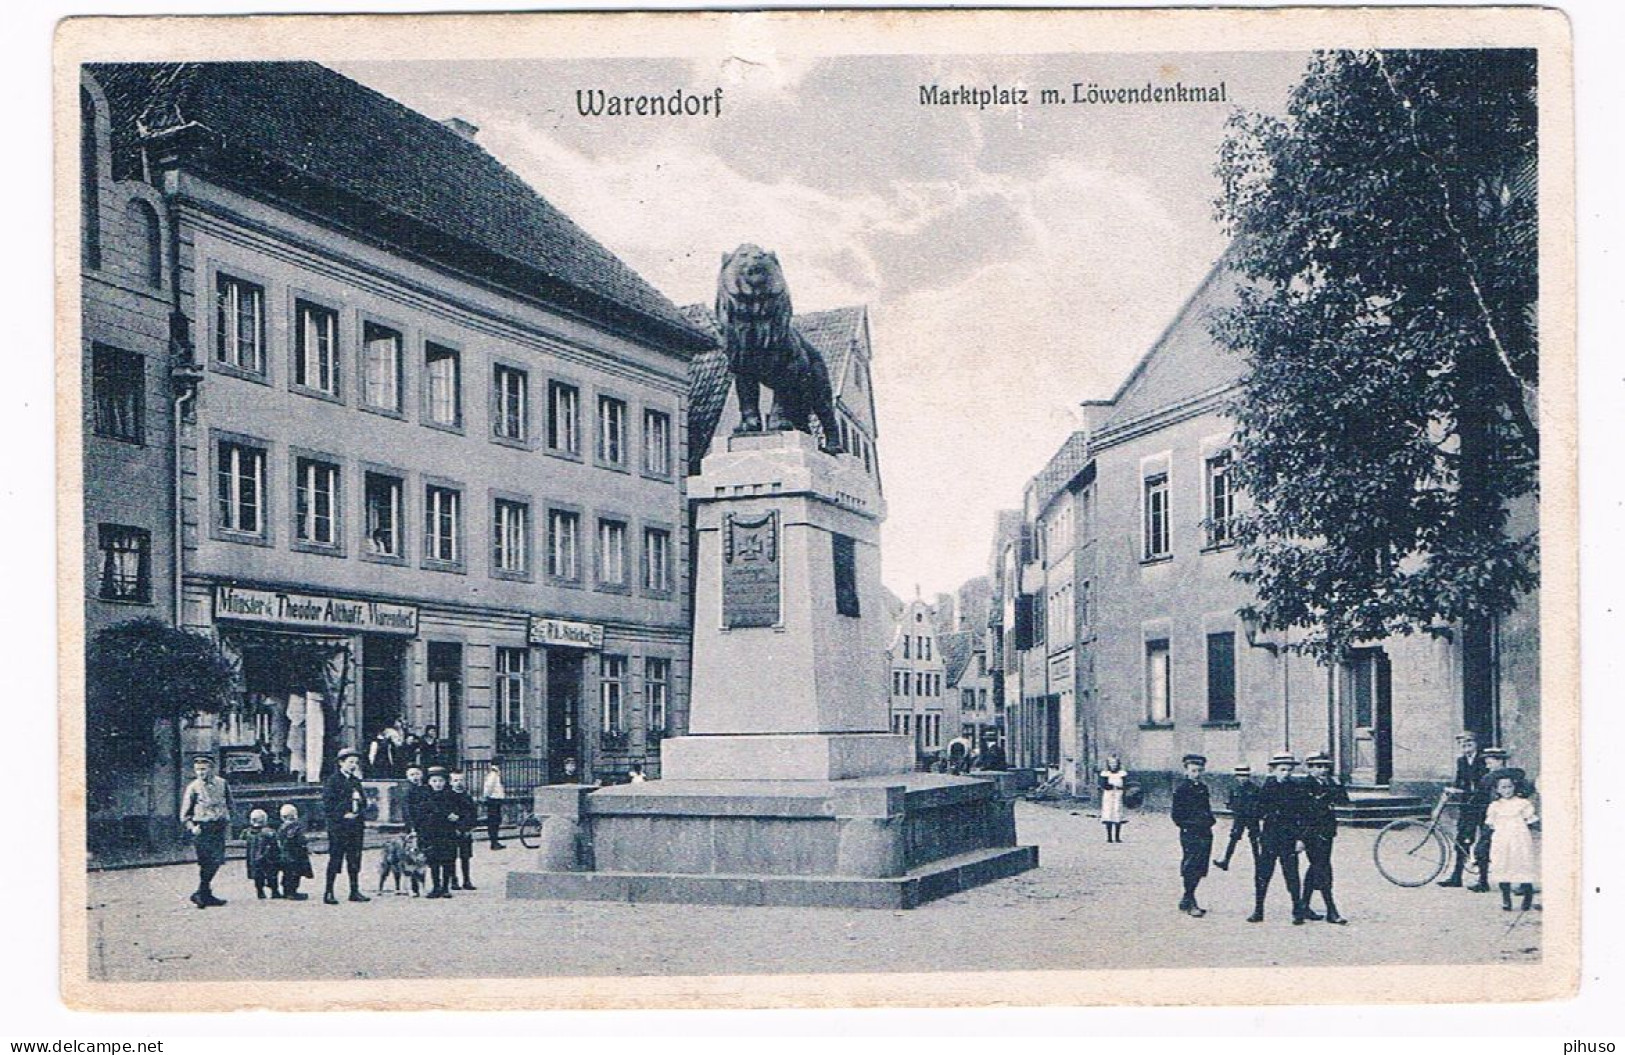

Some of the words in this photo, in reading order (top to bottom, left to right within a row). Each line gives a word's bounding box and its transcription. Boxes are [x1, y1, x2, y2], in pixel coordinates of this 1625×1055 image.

[576, 86, 723, 118] Warendorf
[919, 84, 1029, 109] Marktplatz
[1040, 90, 1066, 104] m.
[1072, 81, 1226, 104] Löwendenkmal
[275, 593, 322, 620] Theodor
